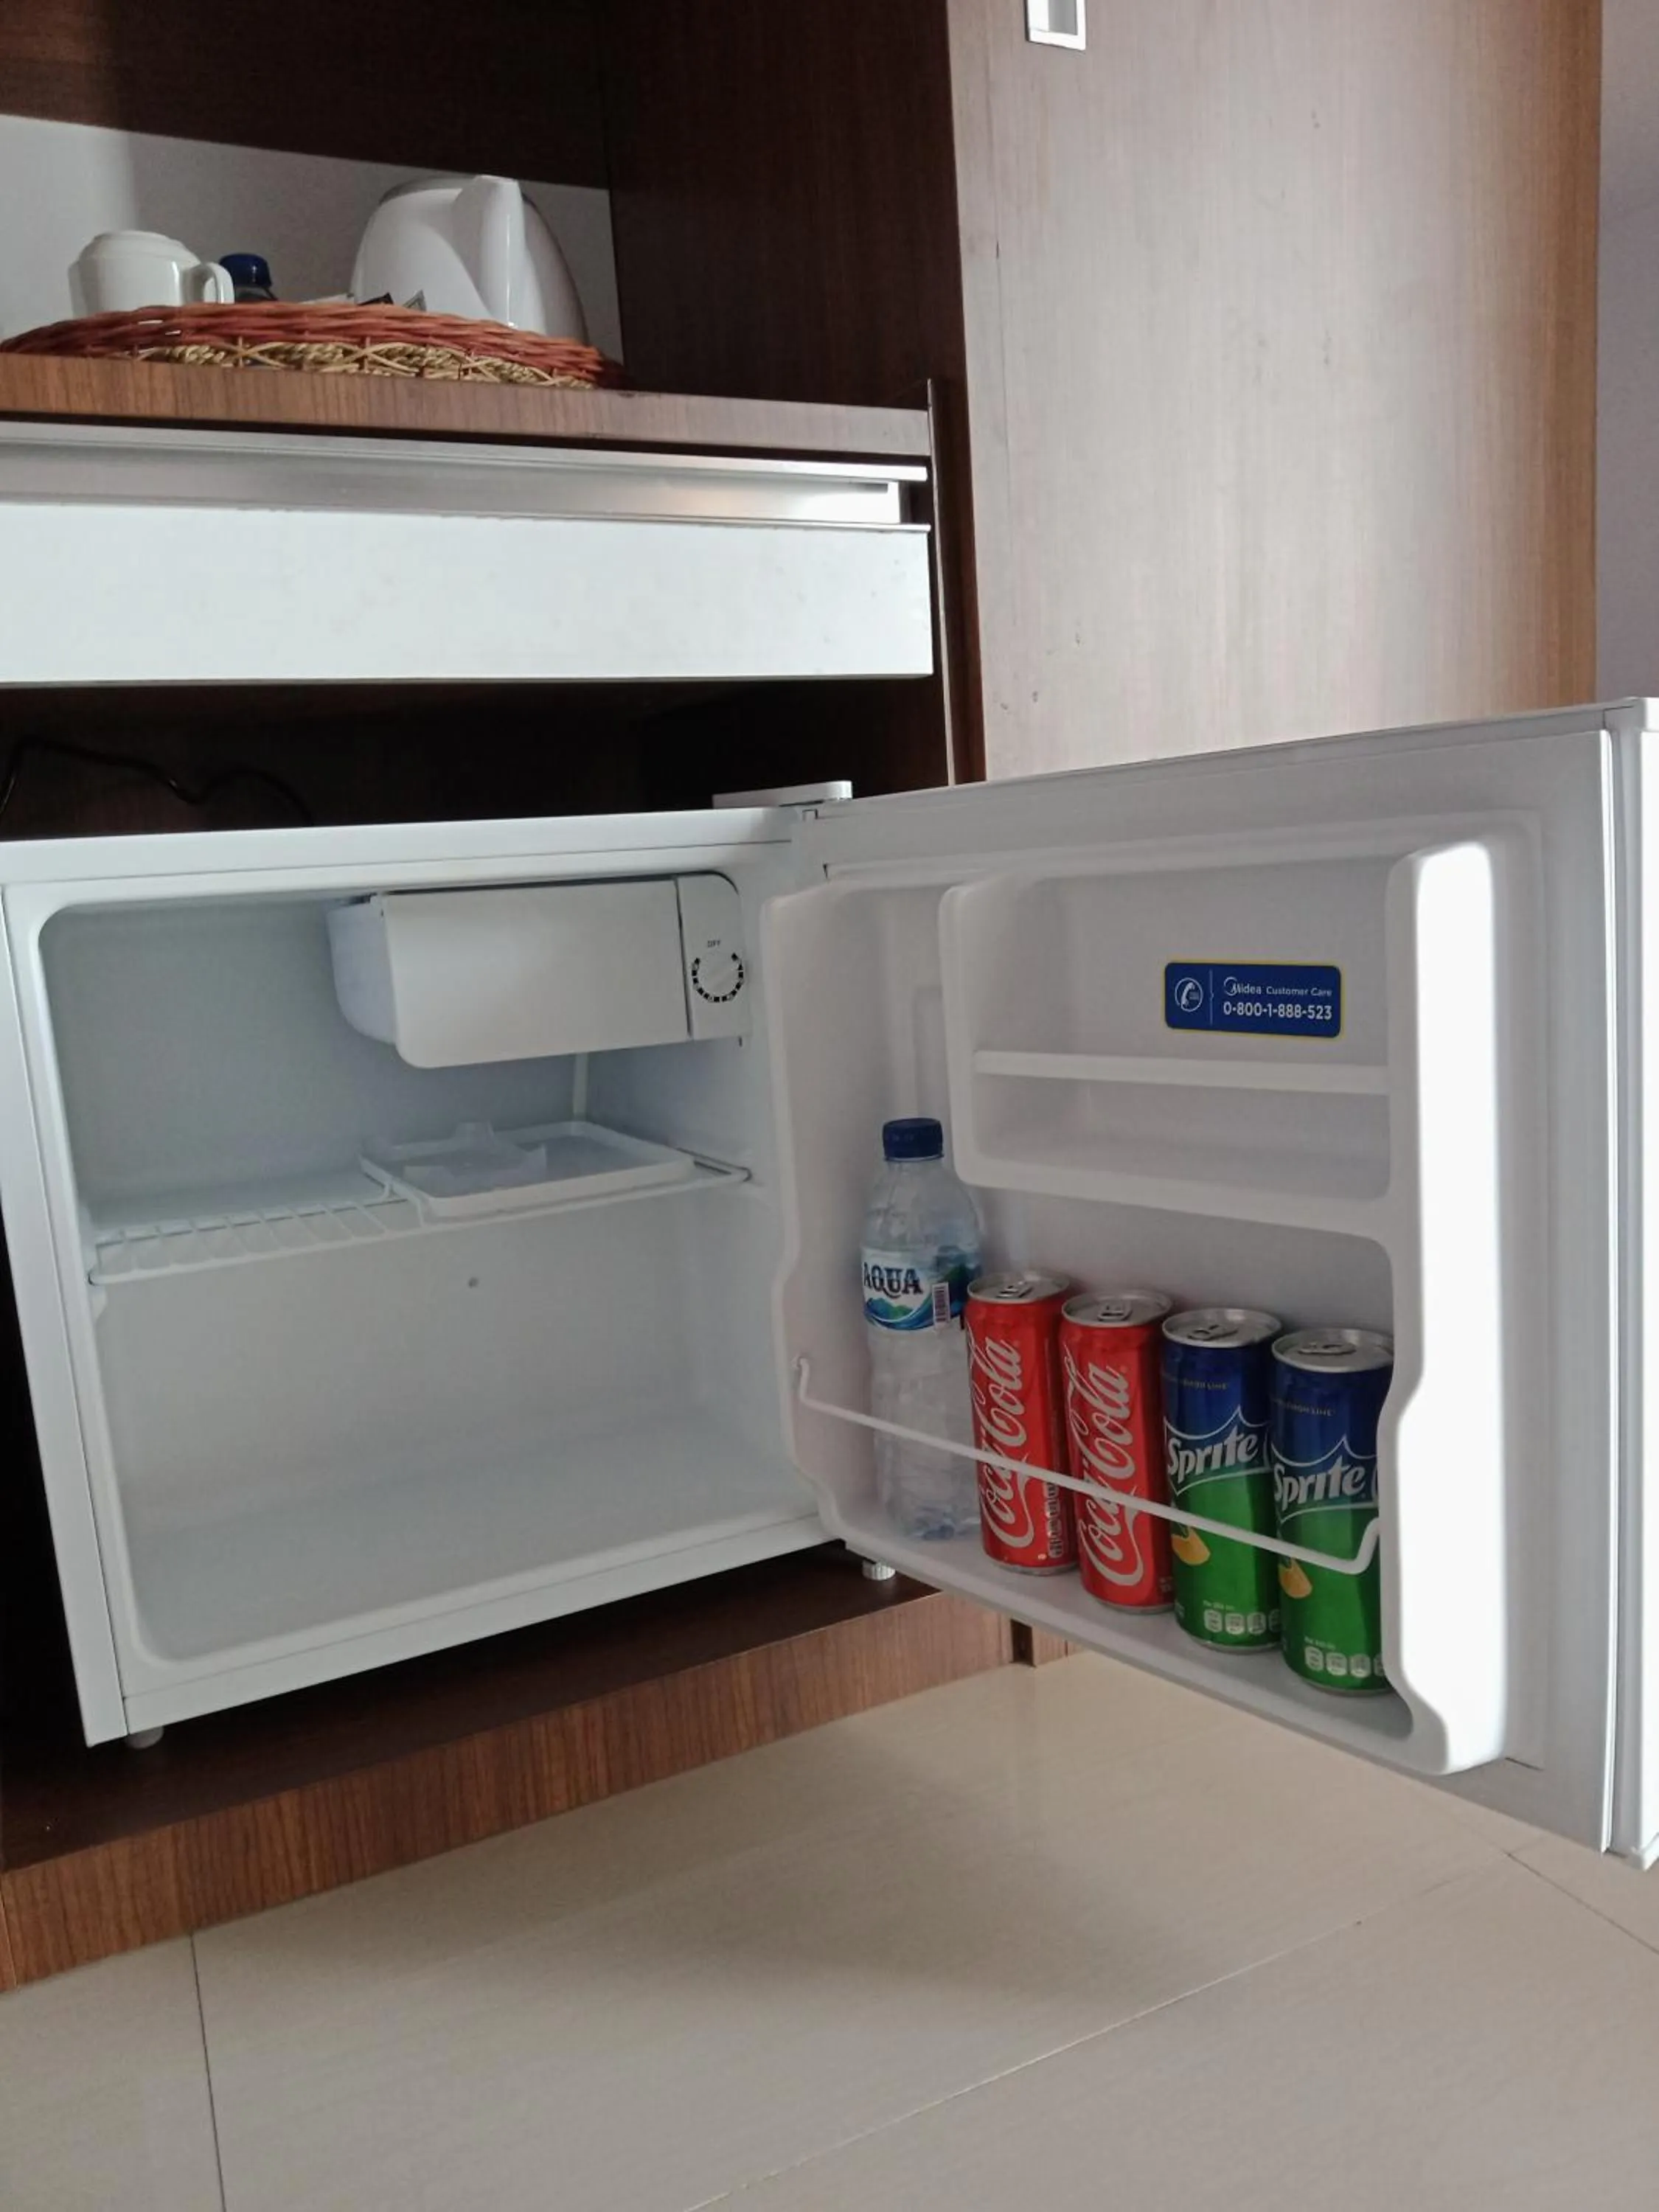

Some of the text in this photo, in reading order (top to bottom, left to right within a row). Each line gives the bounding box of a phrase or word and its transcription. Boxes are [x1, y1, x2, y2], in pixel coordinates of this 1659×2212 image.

[1223, 976, 1332, 997] Midea Customer Care
[1222, 1001, 1333, 1020] 0-800-1-888-523
[863, 1262, 923, 1299] AQUA
[1167, 1425, 1259, 1484] Sprite
[1273, 1455, 1366, 1512] Sprite
